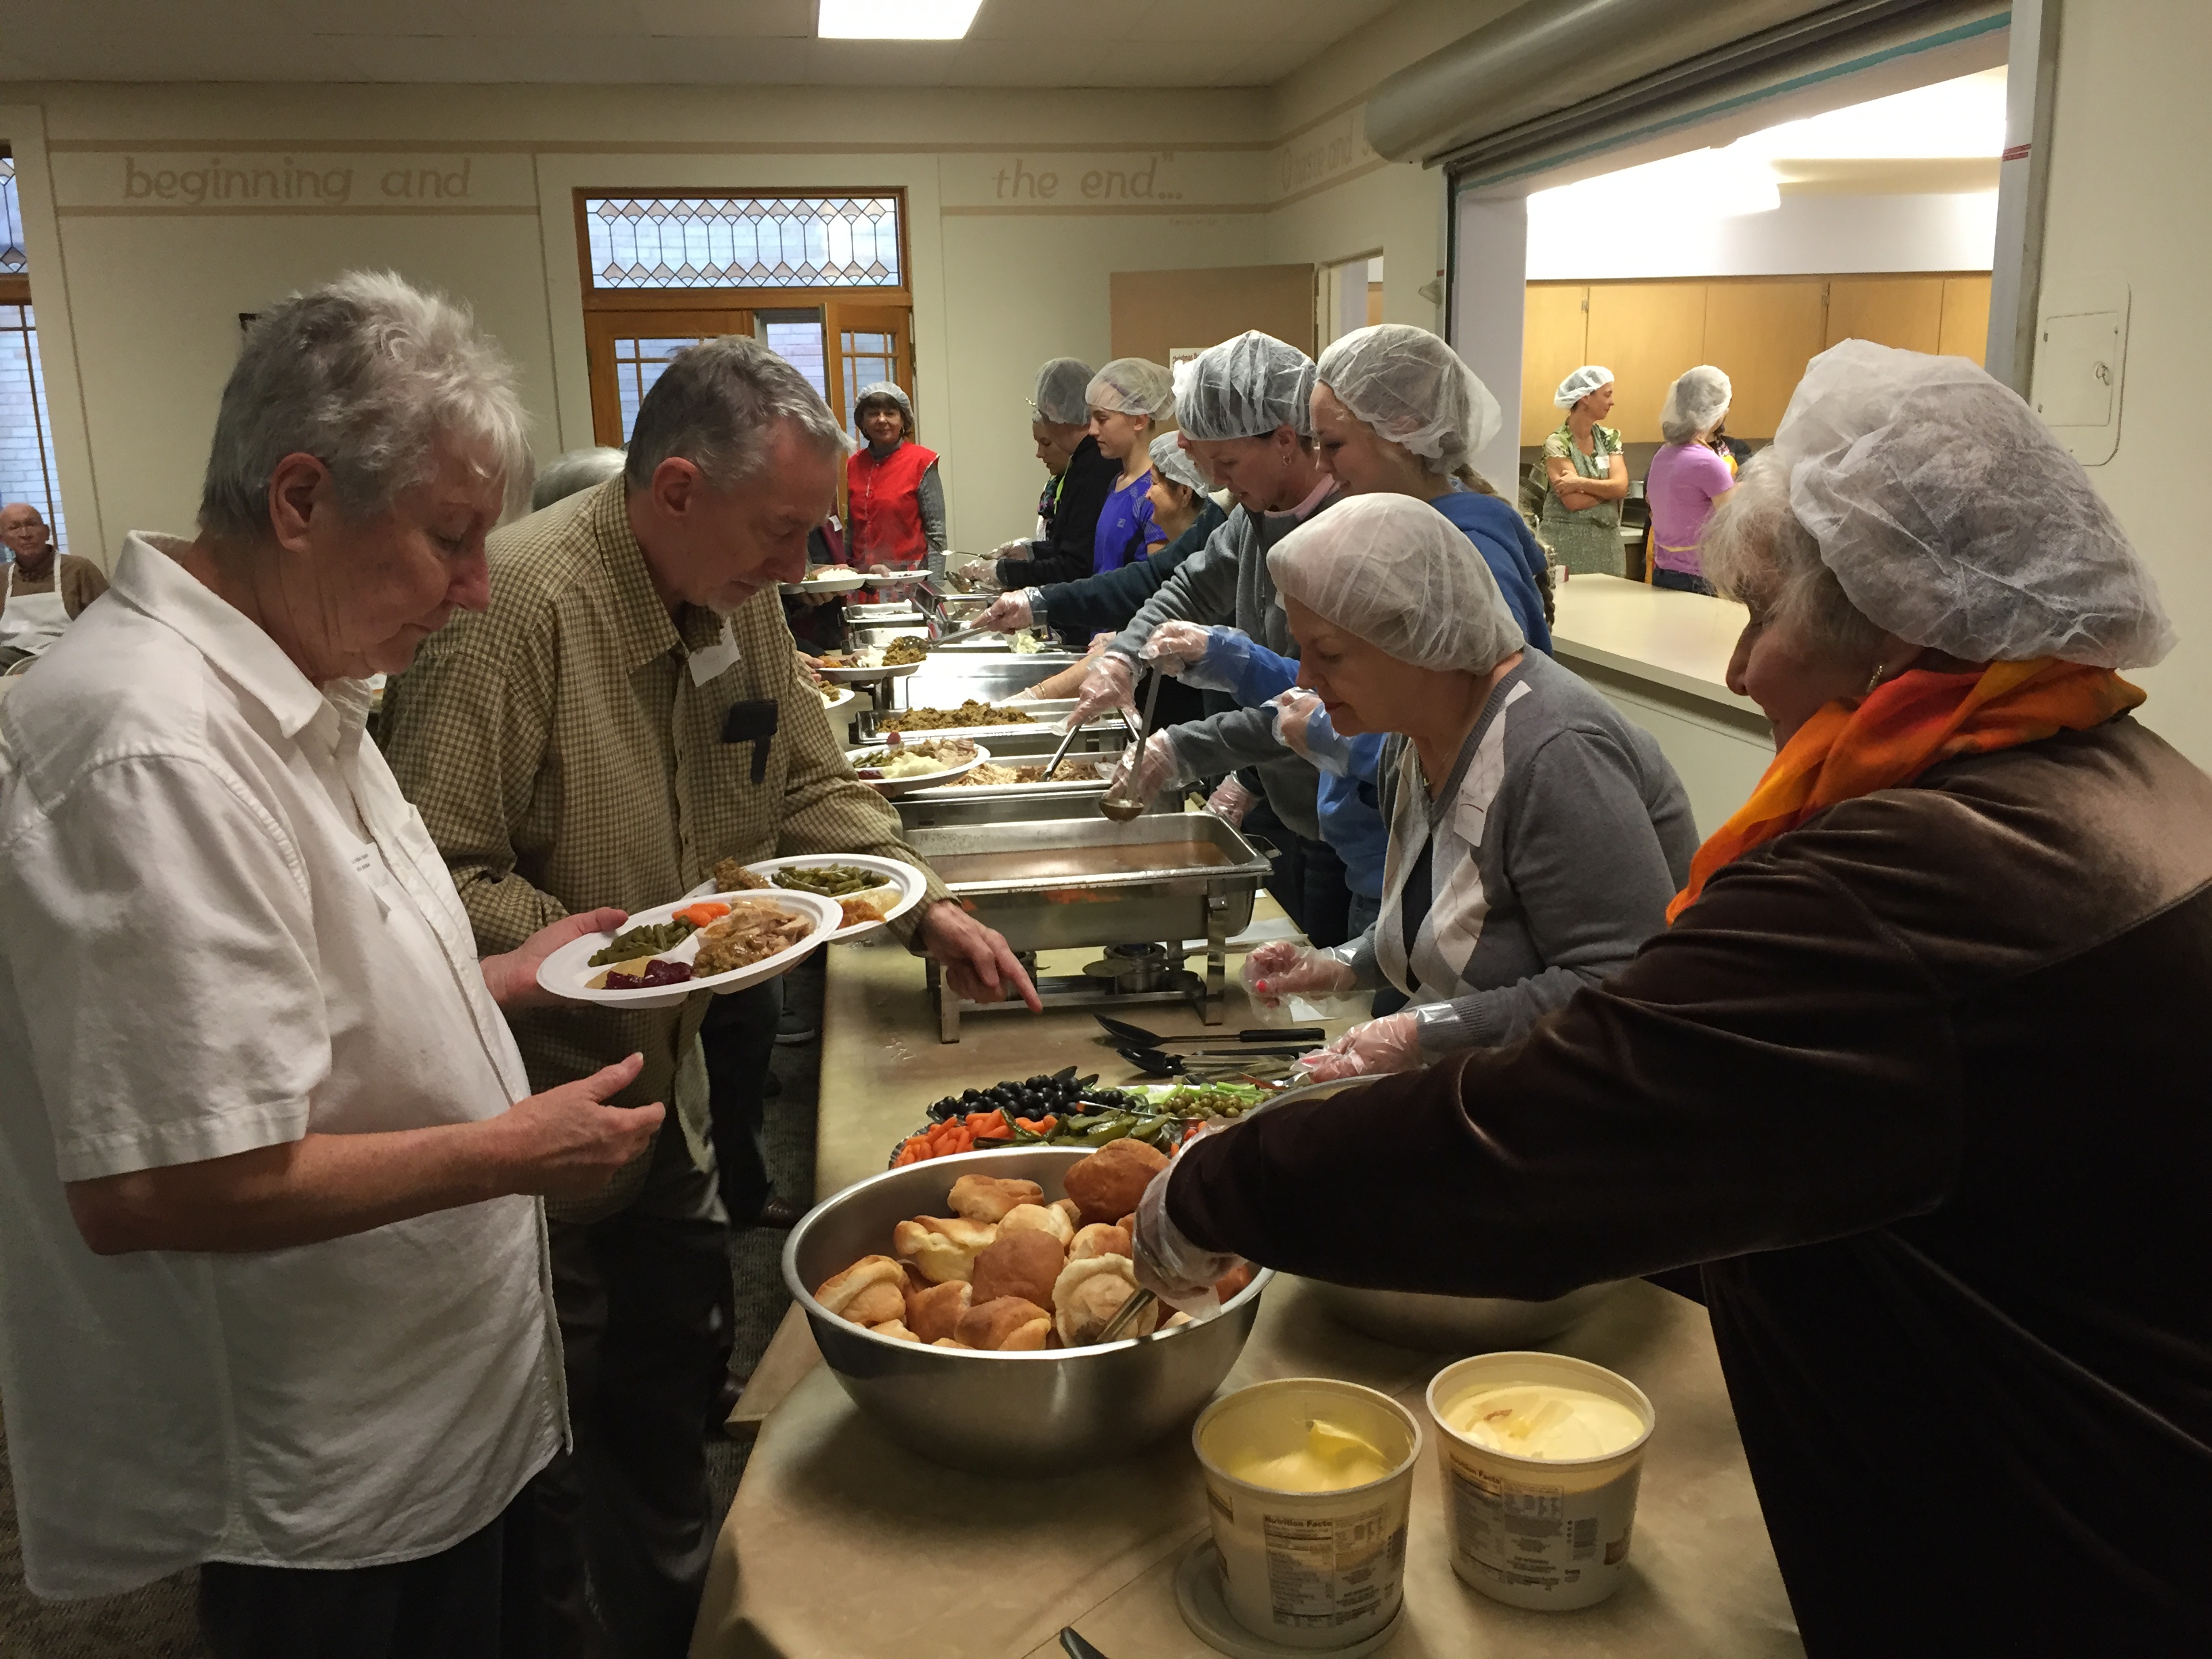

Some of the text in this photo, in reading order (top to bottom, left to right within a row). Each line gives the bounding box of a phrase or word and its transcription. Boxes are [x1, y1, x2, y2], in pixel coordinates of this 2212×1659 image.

[1328, 114, 1353, 170] and
[123, 156, 472, 204] beginning and
[991, 158, 1059, 199] the
[1265, 1514, 1304, 1527] Nutrition
